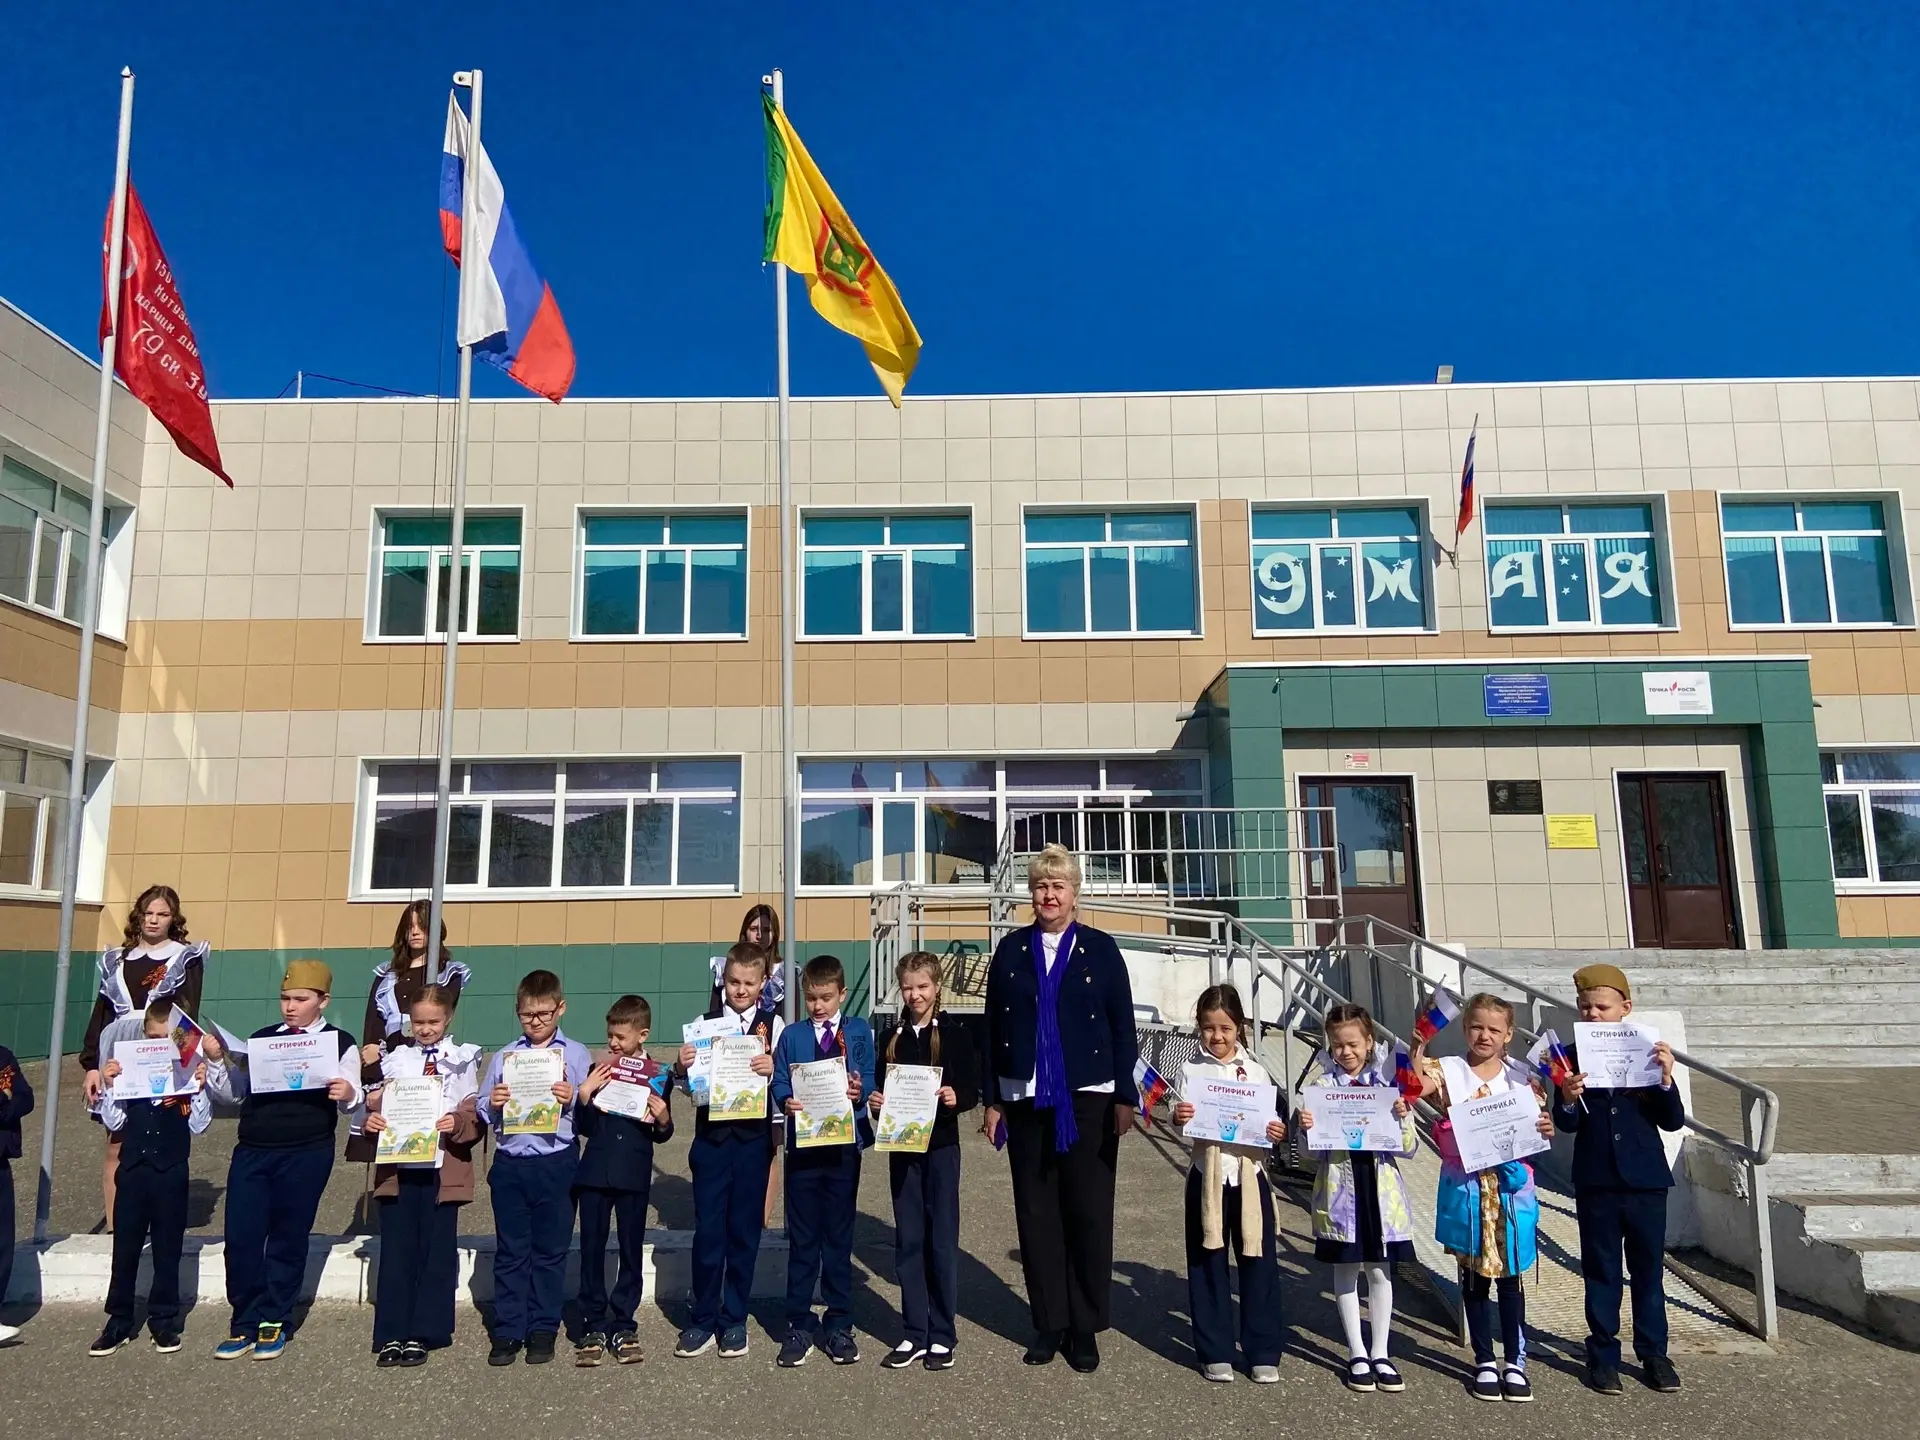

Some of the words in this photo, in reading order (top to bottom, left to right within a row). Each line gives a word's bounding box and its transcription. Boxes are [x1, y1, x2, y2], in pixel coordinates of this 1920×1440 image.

[154, 259, 172, 284] 150
[131, 320, 165, 355] 79
[1258, 551, 1306, 615] 9
[1590, 1030, 1638, 1038] СЕРТИФИКАТ
[268, 1039, 317, 1050] СЕРТИФИКАТ
[720, 1040, 756, 1054] Грамота
[512, 1055, 550, 1069] Грамота
[799, 1067, 836, 1081] Грамота
[894, 1069, 929, 1085] Грамота
[392, 1080, 432, 1096] Грамота
[1207, 1084, 1256, 1098] СЕРТИФИКАТ
[1325, 1093, 1376, 1101] СЕРТИФИКАТ
[1469, 1098, 1517, 1117] СЕРТИФИКАТ
